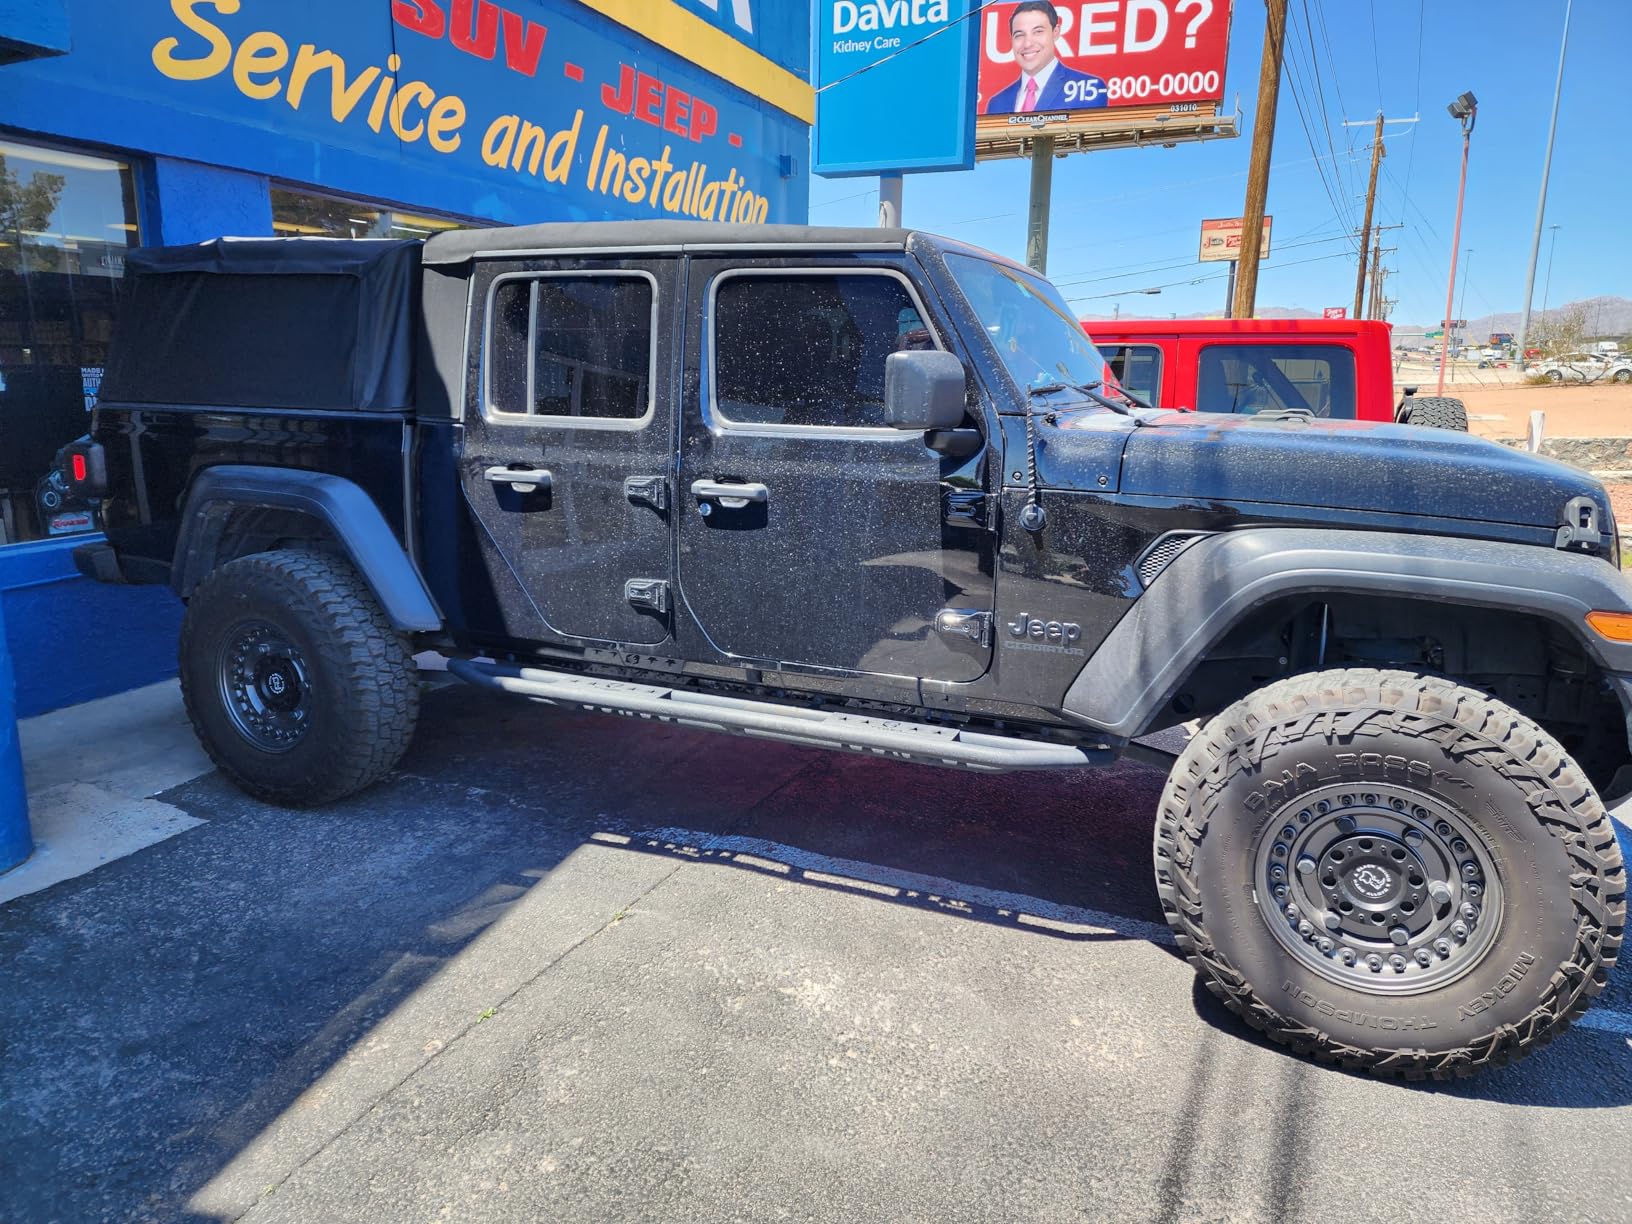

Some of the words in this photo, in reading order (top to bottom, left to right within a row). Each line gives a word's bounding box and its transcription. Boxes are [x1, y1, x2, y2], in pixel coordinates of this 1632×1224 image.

[833, 0, 949, 34] DaVita
[833, 40, 872, 54] Kidney
[874, 36, 901, 49] Care
[391, 0, 548, 78] SUV
[600, 63, 718, 143] JEEP
[1063, 70, 1219, 103] 915-800-0000
[152, 0, 467, 154] Service
[481, 108, 584, 184] and
[586, 124, 769, 225] Installation
[1170, 103, 1199, 113] 031010
[1004, 640, 1085, 656] GLADIATOR
[1007, 612, 1082, 649] Jeep
[1243, 762, 1318, 812] BAJA
[1335, 752, 1432, 778] BOSS
[1281, 978, 1439, 1031] THOMPSON
[1457, 952, 1537, 1022] MICKEY
